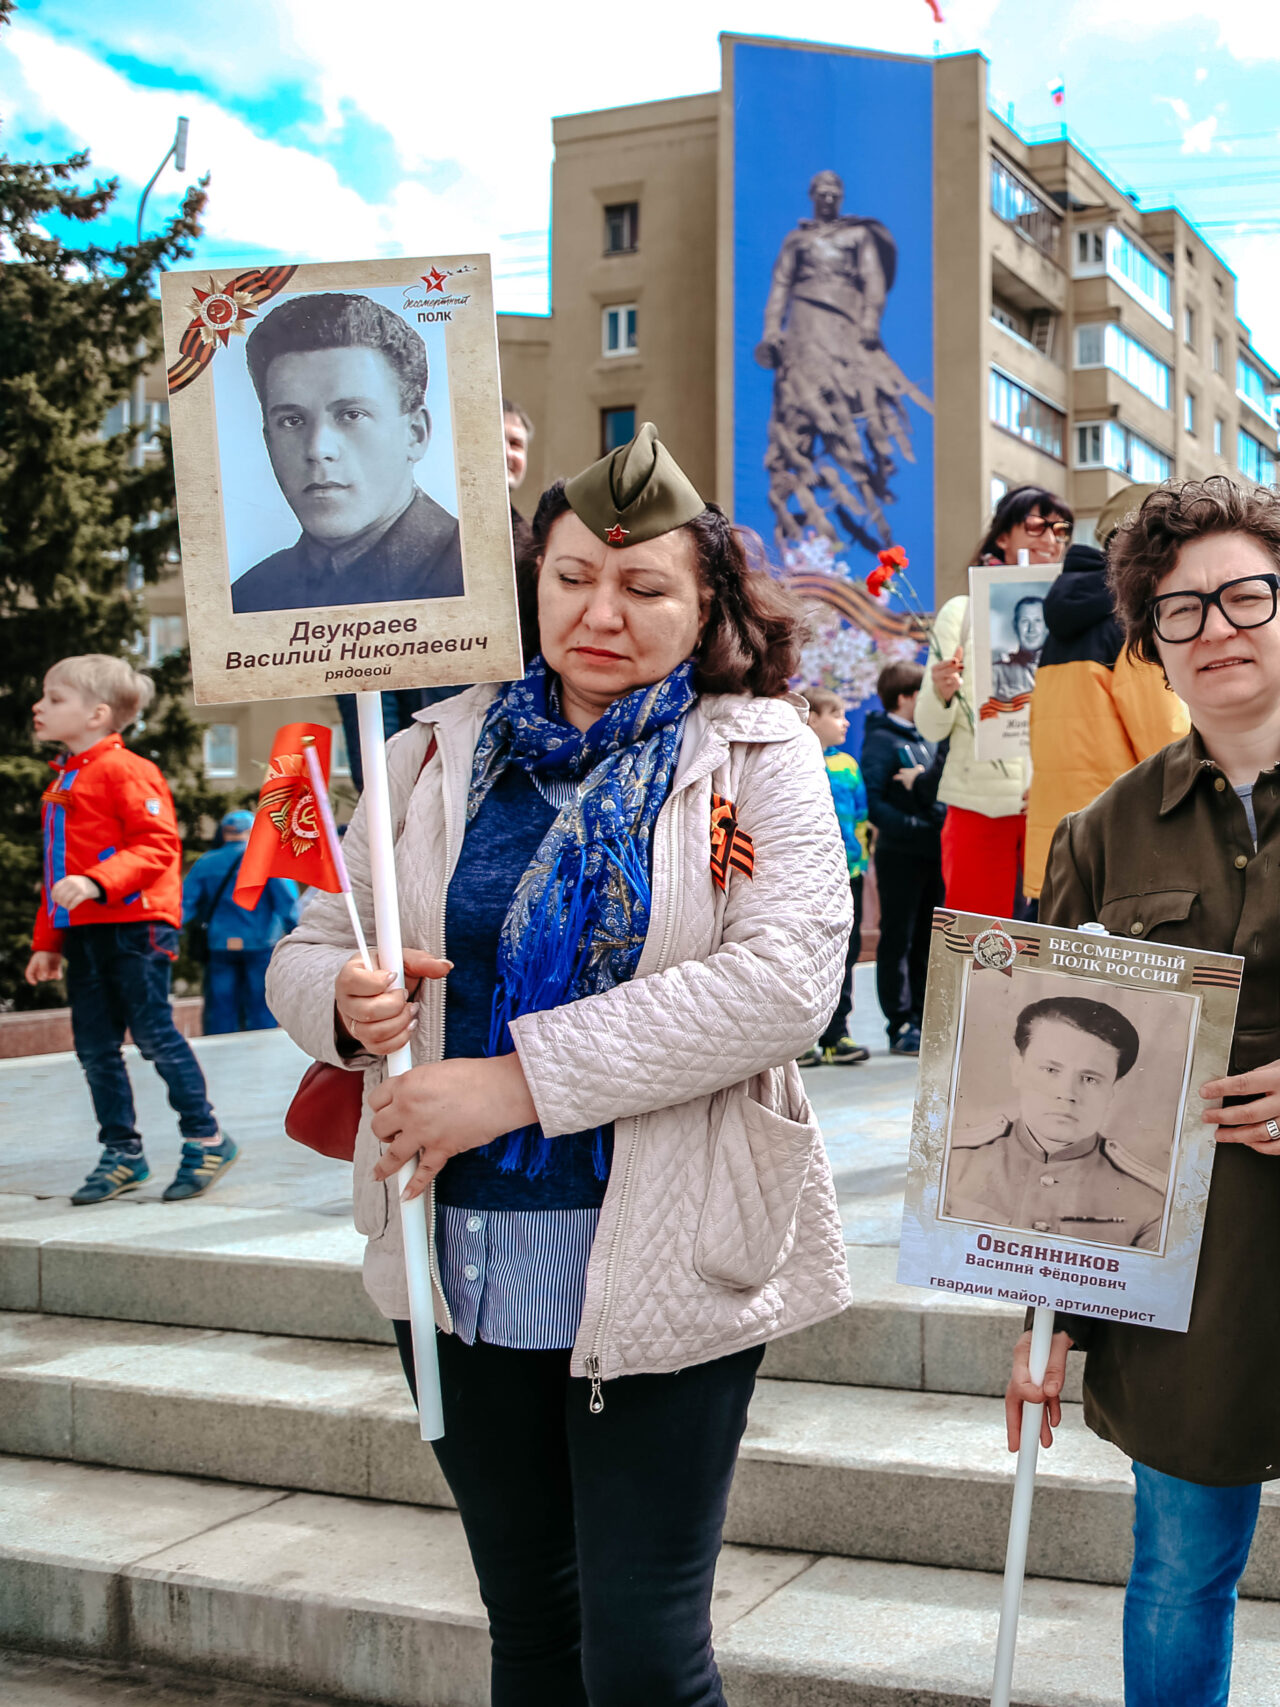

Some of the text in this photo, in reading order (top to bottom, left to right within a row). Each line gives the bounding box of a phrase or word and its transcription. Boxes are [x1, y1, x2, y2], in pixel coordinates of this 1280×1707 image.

[417, 311, 452, 323] ПОЛК
[289, 617, 418, 646] Двукраев
[226, 636, 488, 670] Василий Николаевич
[325, 664, 392, 682] рядовой
[1048, 937, 1187, 970] БЕССМЕРТНЫЙ
[1051, 953, 1180, 984] ПОЛК РОССИИ
[977, 1233, 1120, 1273] Овсянников
[965, 1253, 1127, 1291] Василий Фёдорович
[930, 1276, 1156, 1323] гвардии майор, артиллерист
